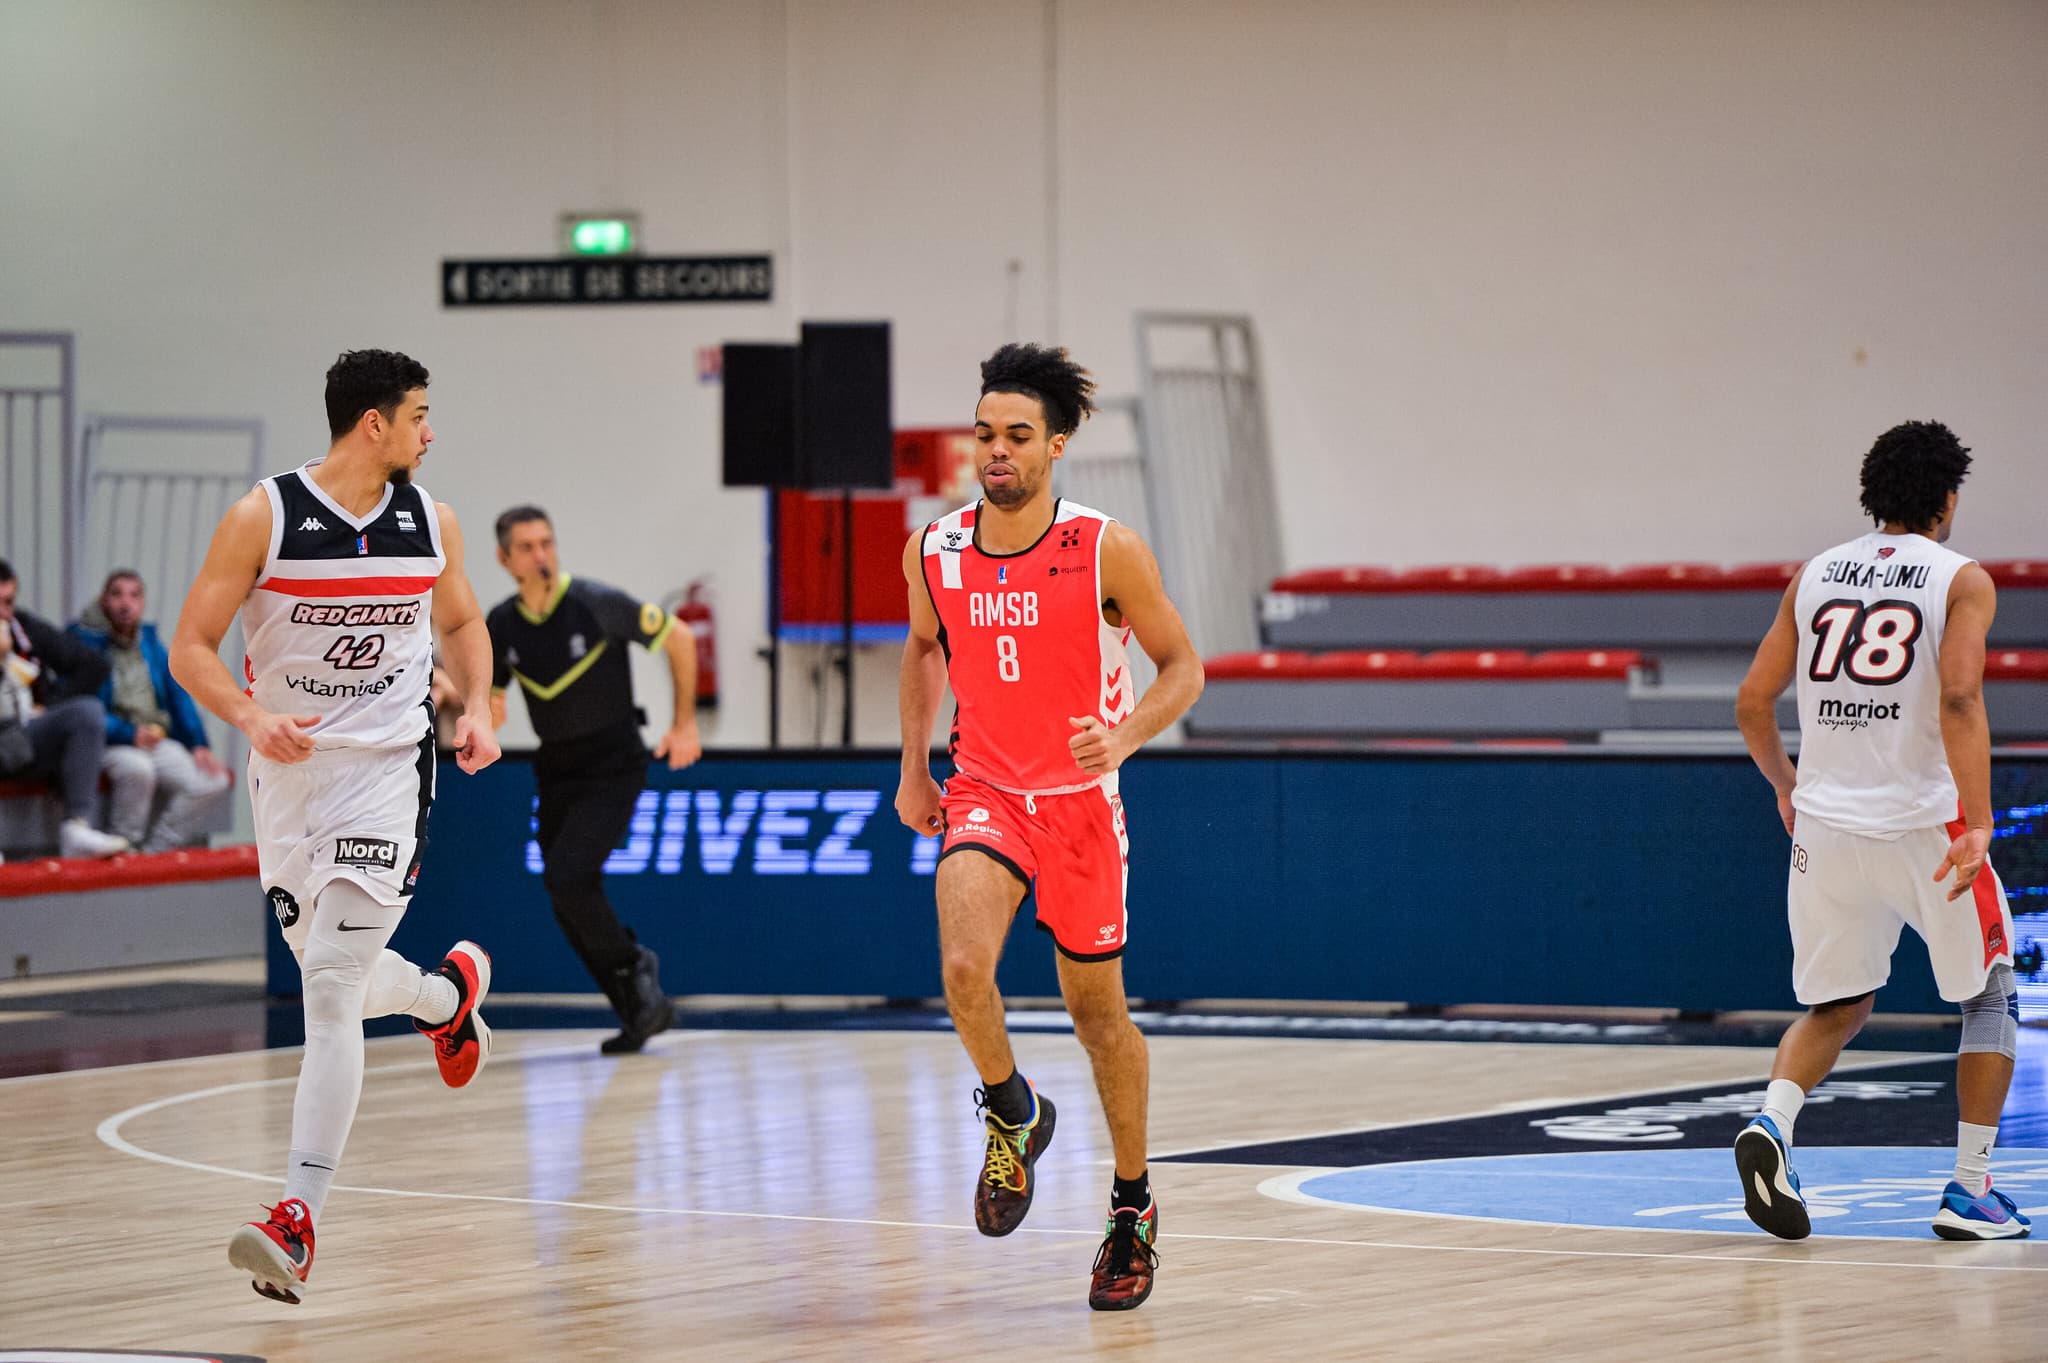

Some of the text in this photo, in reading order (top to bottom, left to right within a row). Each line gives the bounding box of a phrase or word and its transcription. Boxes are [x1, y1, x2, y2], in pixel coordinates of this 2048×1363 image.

[584, 266, 624, 297] DE
[633, 263, 770, 297] SECOURS
[1821, 560, 1931, 589] SUKA-UMU
[969, 591, 1039, 627] AMSB
[324, 634, 385, 670] 42
[996, 635, 1021, 682] 8
[1809, 598, 1923, 686] 18
[1817, 717, 1868, 731] voyages
[1818, 698, 1900, 720] mariot
[526, 790, 881, 874] UIVEZ
[338, 840, 394, 861] Nord
[1793, 845, 1808, 874] 18
